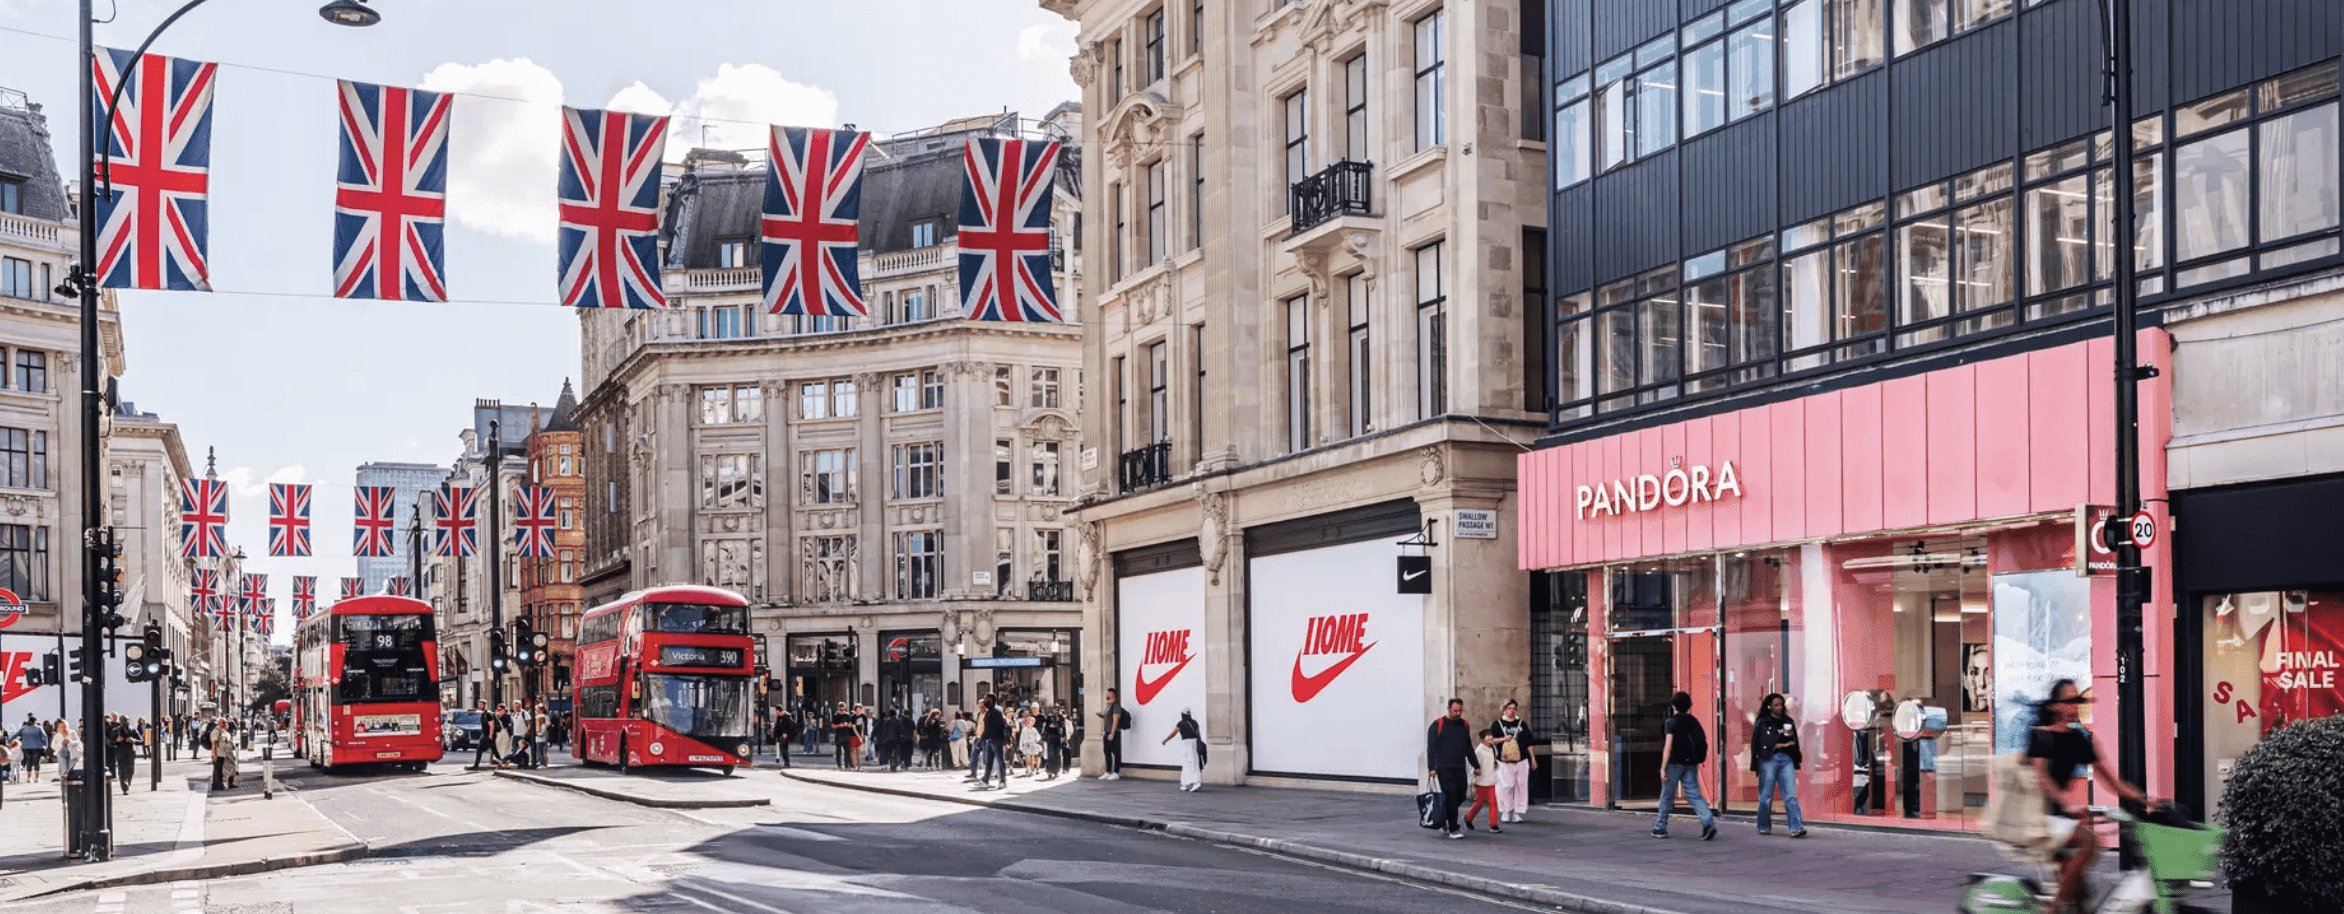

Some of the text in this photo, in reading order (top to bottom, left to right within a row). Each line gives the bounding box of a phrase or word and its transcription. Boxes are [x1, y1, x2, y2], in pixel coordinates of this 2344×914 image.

[1577, 460, 1741, 520] PANDORA
[1458, 512, 1488, 520] SWALLOW
[1458, 521, 1484, 529] PASSAGE
[2135, 523, 2153, 538] 20
[377, 635, 393, 647] 98
[672, 650, 738, 664] Victoria 390
[2275, 651, 2340, 669] FINAL
[2279, 671, 2335, 689] SALE
